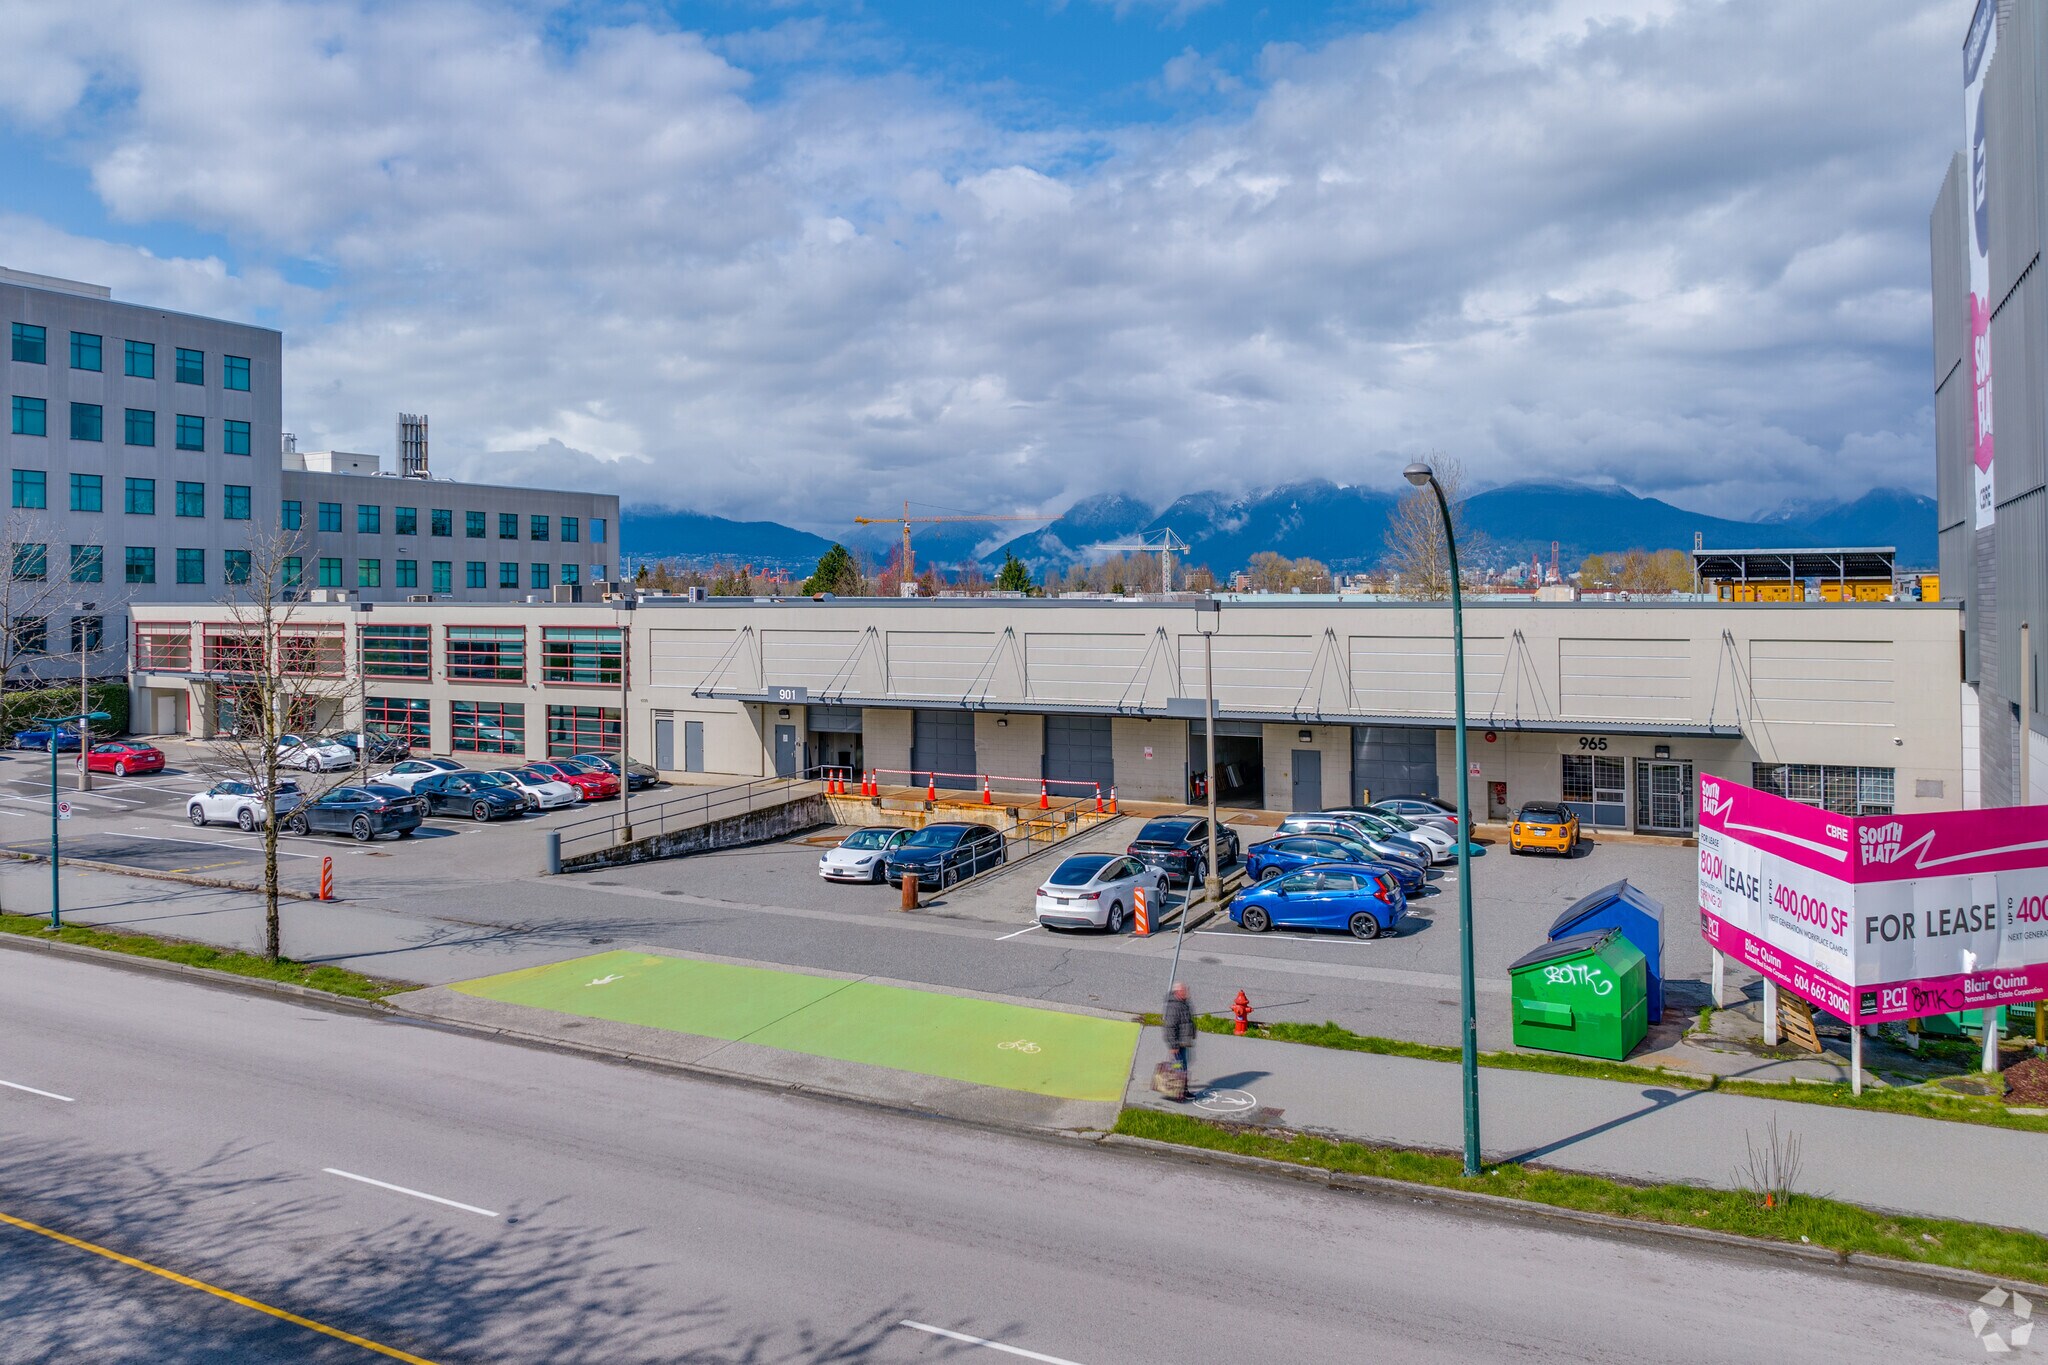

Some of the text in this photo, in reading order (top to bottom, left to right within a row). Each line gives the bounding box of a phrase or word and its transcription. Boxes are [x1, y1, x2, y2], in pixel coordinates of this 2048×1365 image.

[779, 689, 796, 700] 901
[1579, 736, 1608, 751] 965
[1702, 780, 1720, 800] SOUTH
[1701, 832, 1719, 848] FOR LEASE
[1826, 824, 1848, 842] CBRE
[1858, 822, 1903, 844] SOUTH
[1724, 864, 1759, 903] LEASE
[1774, 883, 1848, 937] 400,000 SF
[2007, 897, 2013, 925] UP TO
[1708, 916, 1719, 938] PCI
[1865, 903, 1996, 944] FOR LEASE
[1768, 913, 1848, 957] NEXT GENERATION WORKPLACE CAMPUS
[2007, 932, 2022, 941] NEXT
[1744, 937, 1760, 955] Blair
[1760, 947, 1782, 969] Quinn
[1794, 973, 1809, 993] 604
[1811, 982, 1826, 1003] 662
[1828, 991, 1850, 1015] 3000
[1964, 973, 2028, 994] Blair Quinn
[1986, 992, 1998, 1000] Real
[2014, 986, 2044, 997] Corporation
[1882, 987, 1908, 1008] PCI
